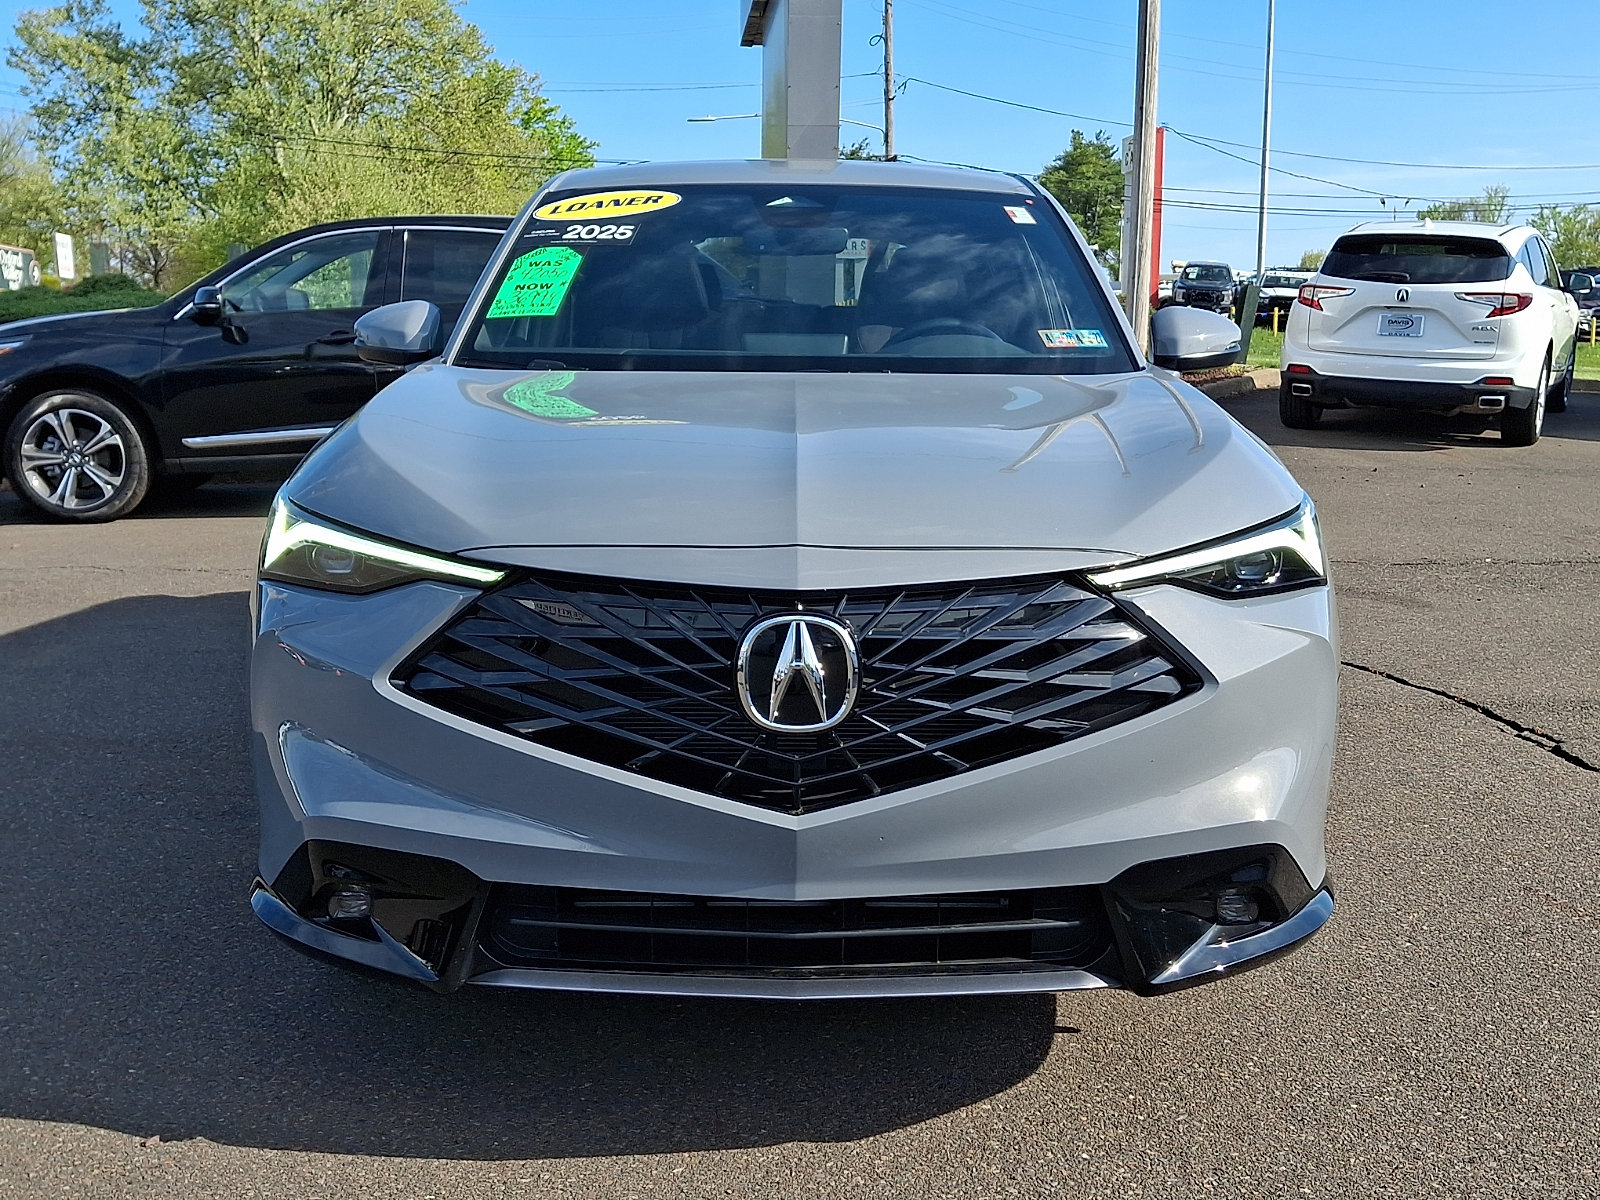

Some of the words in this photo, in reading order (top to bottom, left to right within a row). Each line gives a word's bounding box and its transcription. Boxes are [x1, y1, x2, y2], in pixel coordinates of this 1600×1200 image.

[548, 195, 664, 215] LOANER
[561, 224, 635, 240] 2025
[528, 260, 564, 268] WAS
[514, 282, 554, 291] NOW
[1387, 319, 1410, 327] DAVIS
